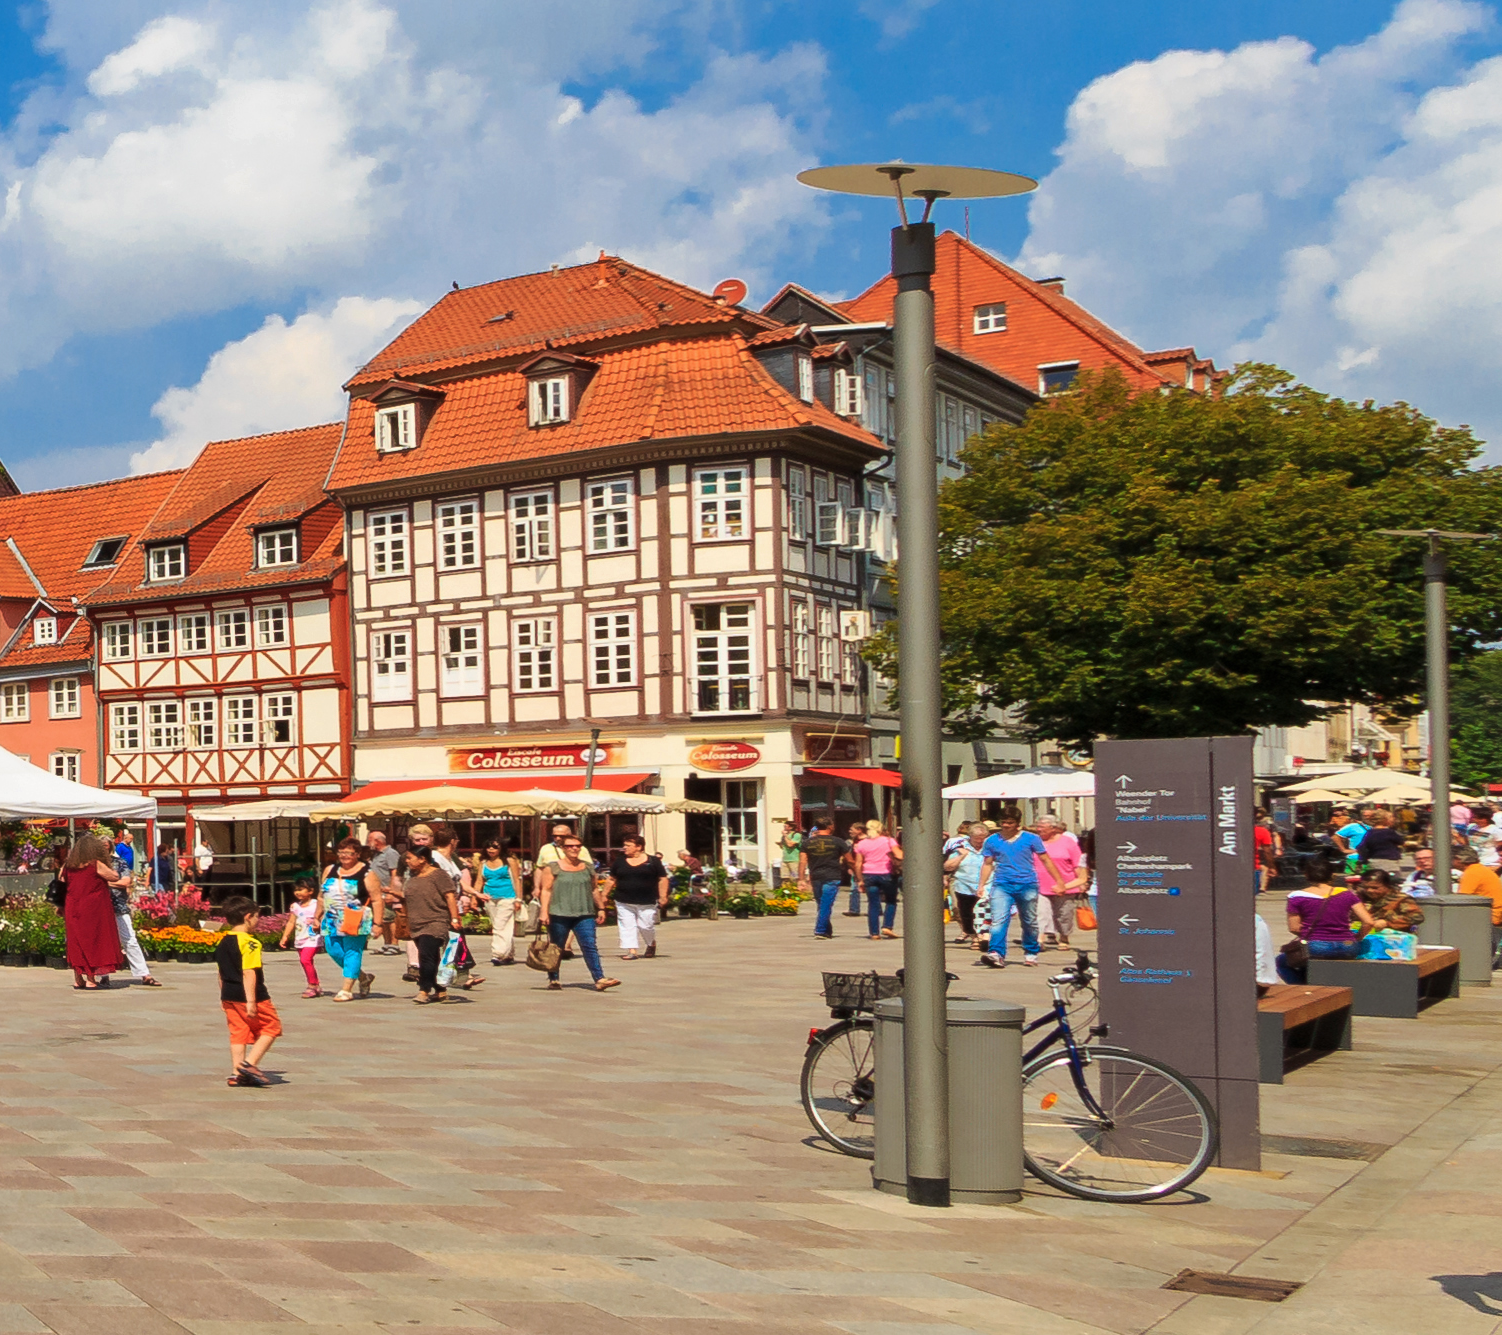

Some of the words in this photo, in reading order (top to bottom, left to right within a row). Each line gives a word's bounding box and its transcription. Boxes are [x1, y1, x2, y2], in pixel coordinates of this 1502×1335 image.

[466, 752, 576, 769] Colosseum
[691, 750, 759, 761] Colosseum
[1218, 785, 1236, 828] Markt
[1218, 830, 1237, 856] Am
